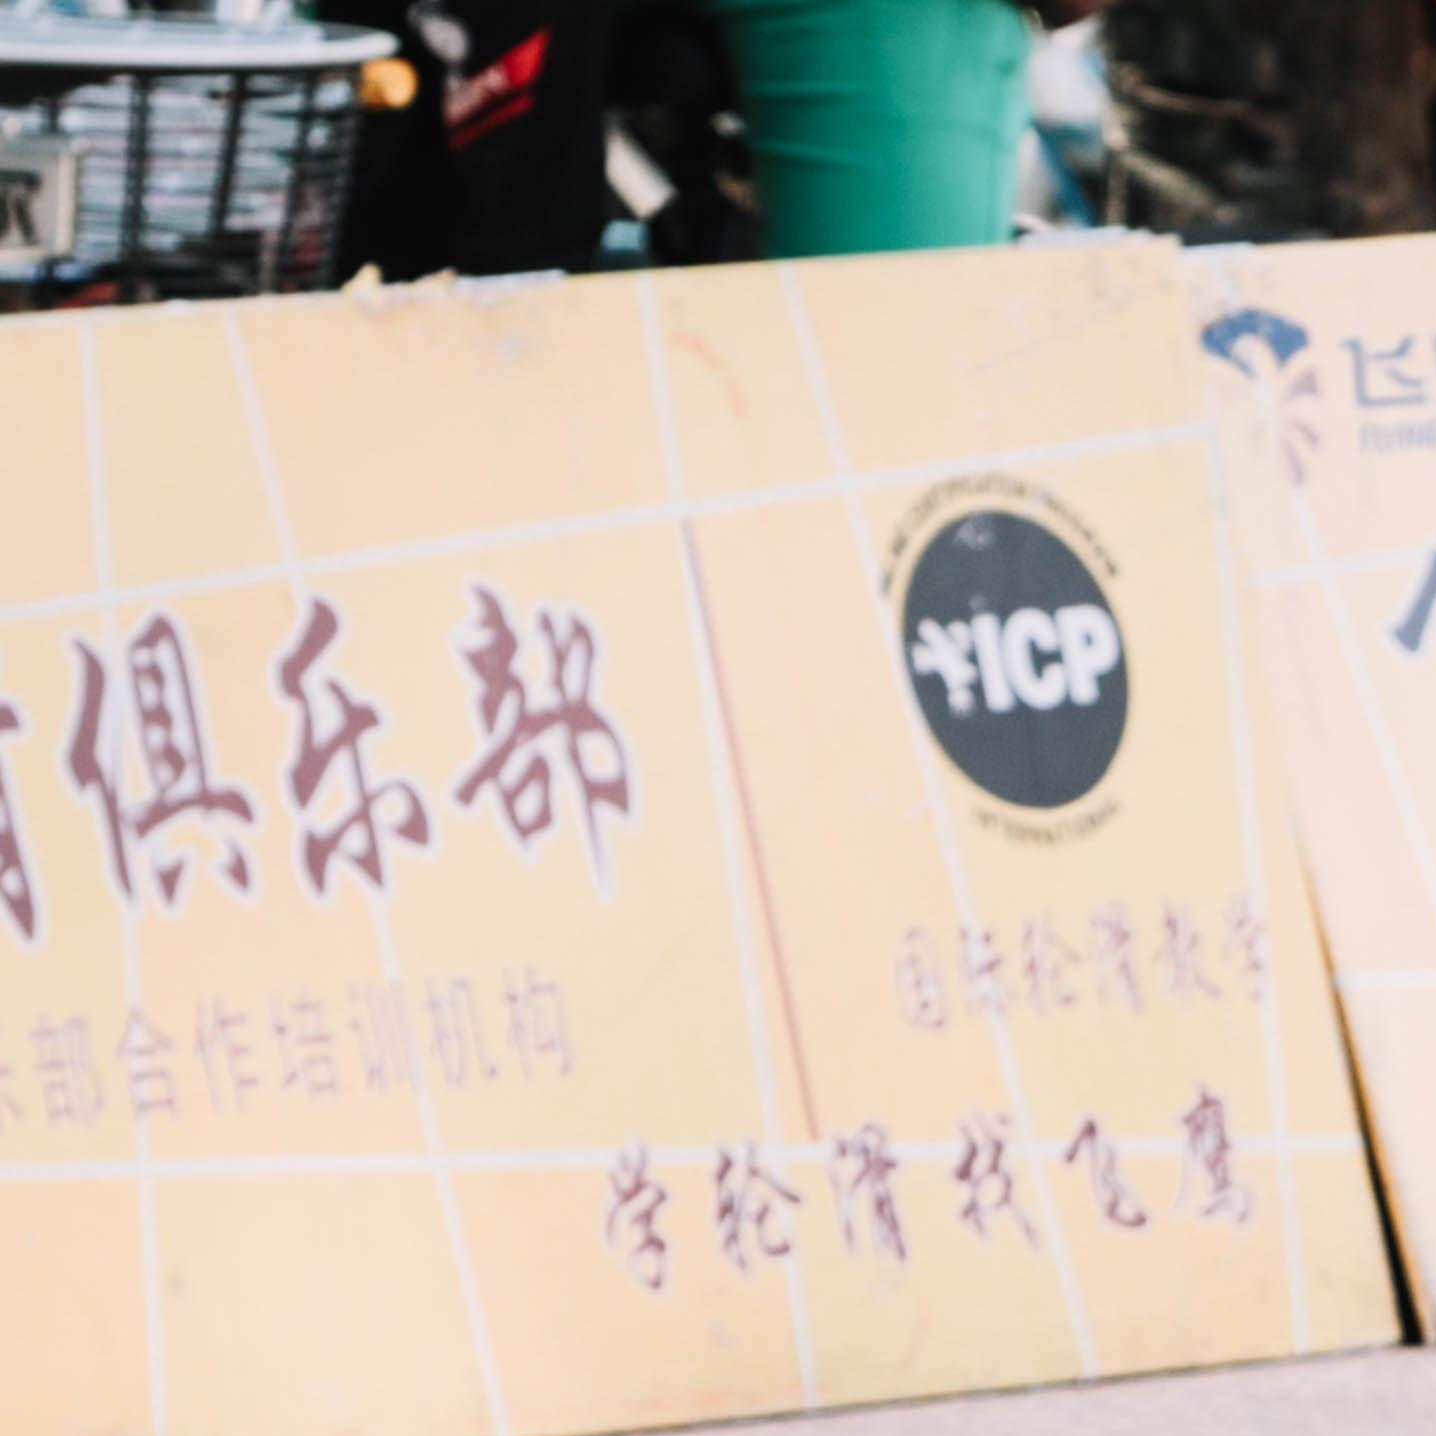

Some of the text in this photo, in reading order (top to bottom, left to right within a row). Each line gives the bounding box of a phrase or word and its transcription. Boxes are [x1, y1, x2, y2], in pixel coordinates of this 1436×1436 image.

[0, 583, 630, 942] 俱乐部
[970, 603, 1122, 714] ICP
